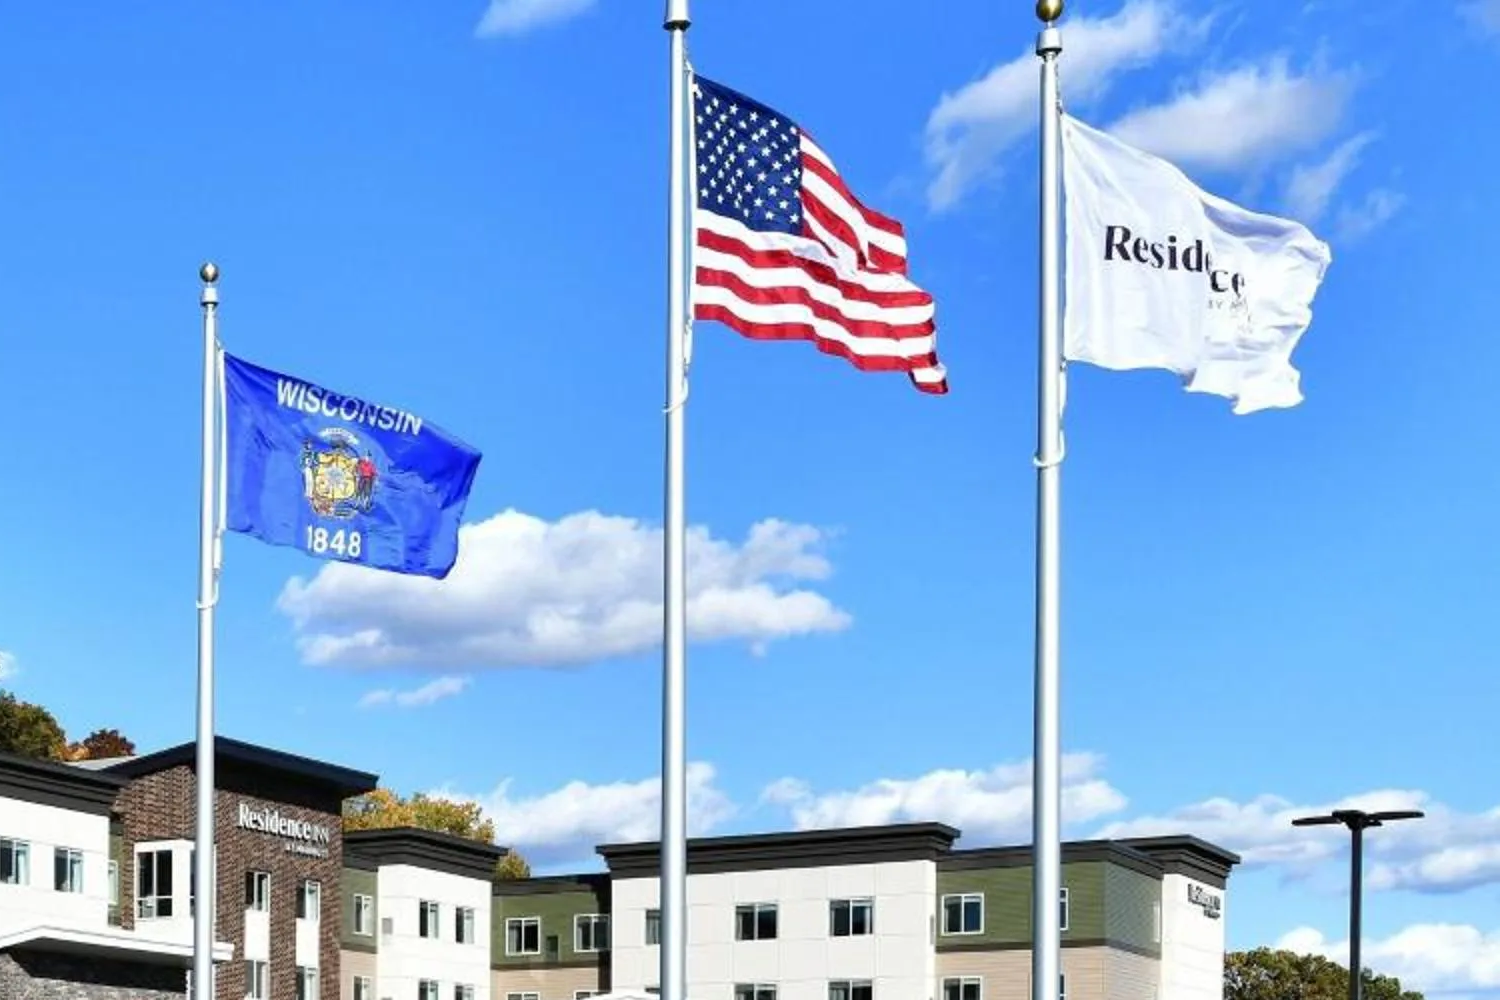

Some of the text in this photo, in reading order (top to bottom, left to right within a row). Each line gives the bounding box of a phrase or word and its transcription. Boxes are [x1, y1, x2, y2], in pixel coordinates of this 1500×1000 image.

[277, 378, 422, 435] WISCONSIN
[306, 525, 362, 557] 1848
[239, 803, 311, 839] Residence
